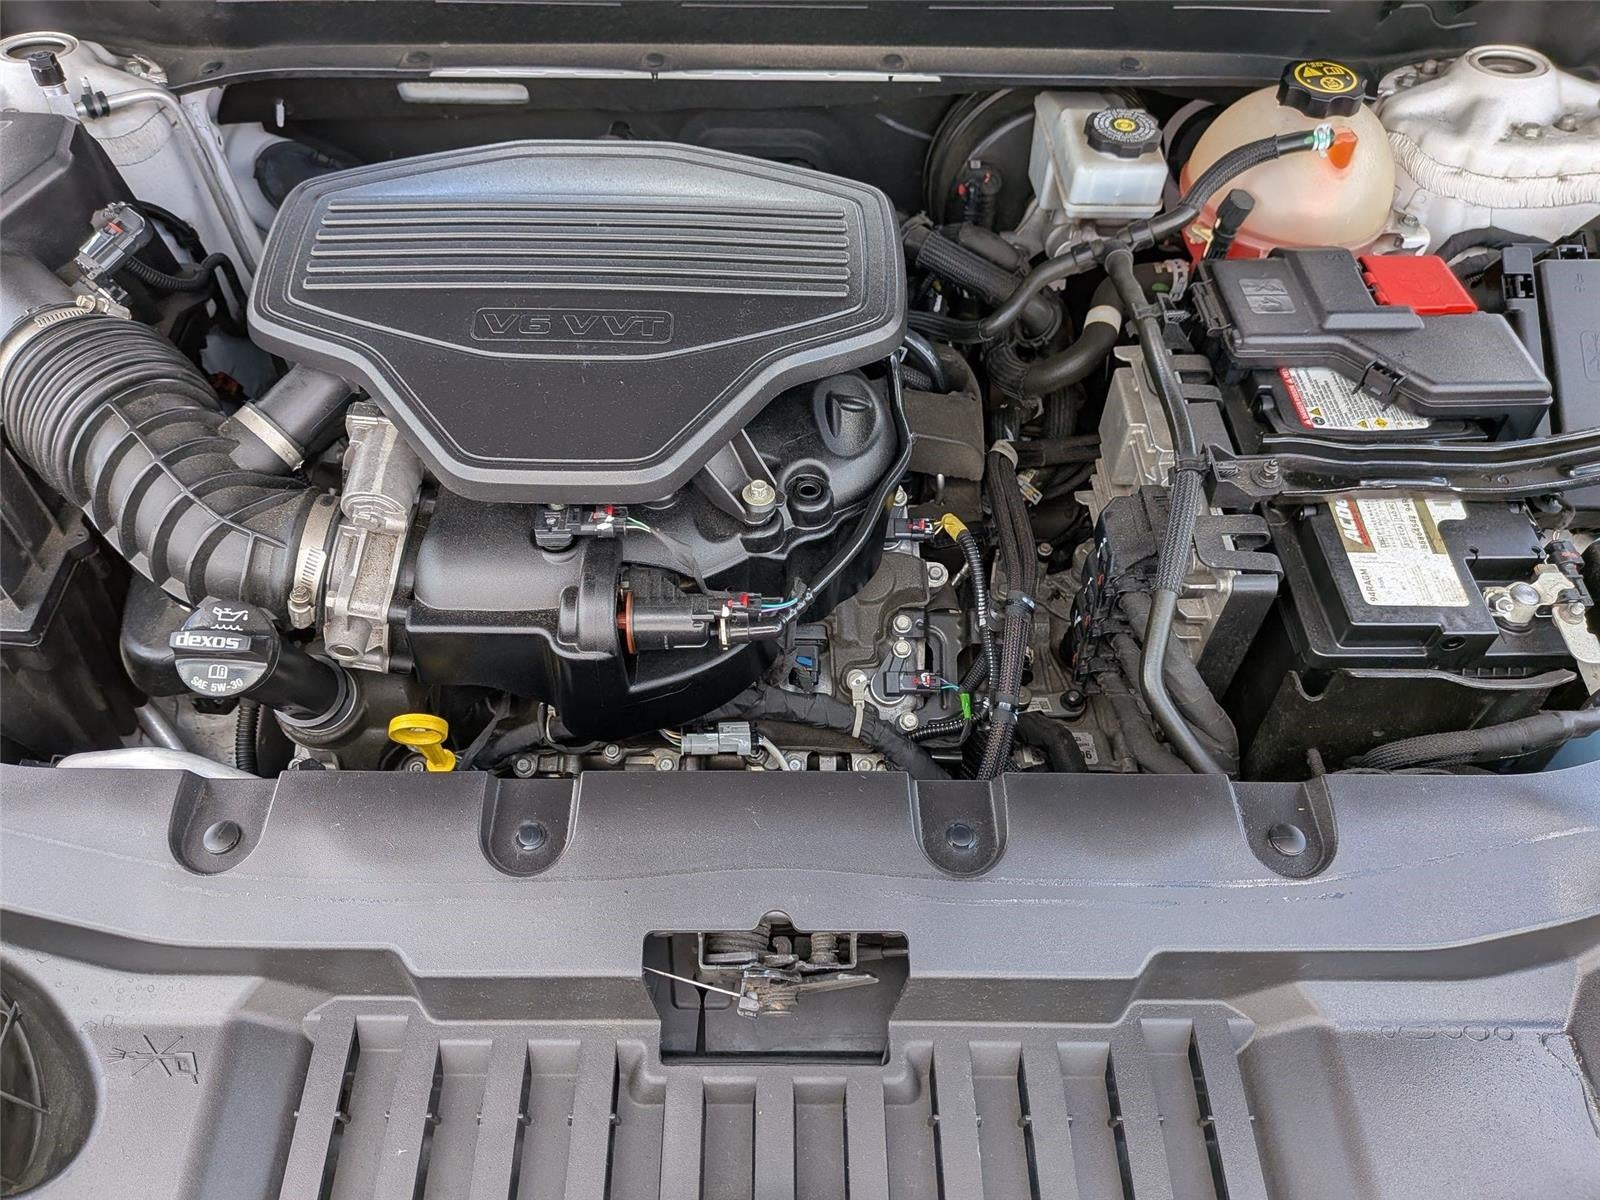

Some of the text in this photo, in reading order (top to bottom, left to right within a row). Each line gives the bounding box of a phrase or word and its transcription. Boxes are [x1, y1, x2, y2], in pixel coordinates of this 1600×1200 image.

[483, 314, 665, 336] V6 VVT
[1360, 568, 1378, 602] 94RAGM
[175, 631, 242, 650] dexos
[191, 676, 243, 692] SAE 5W-30
